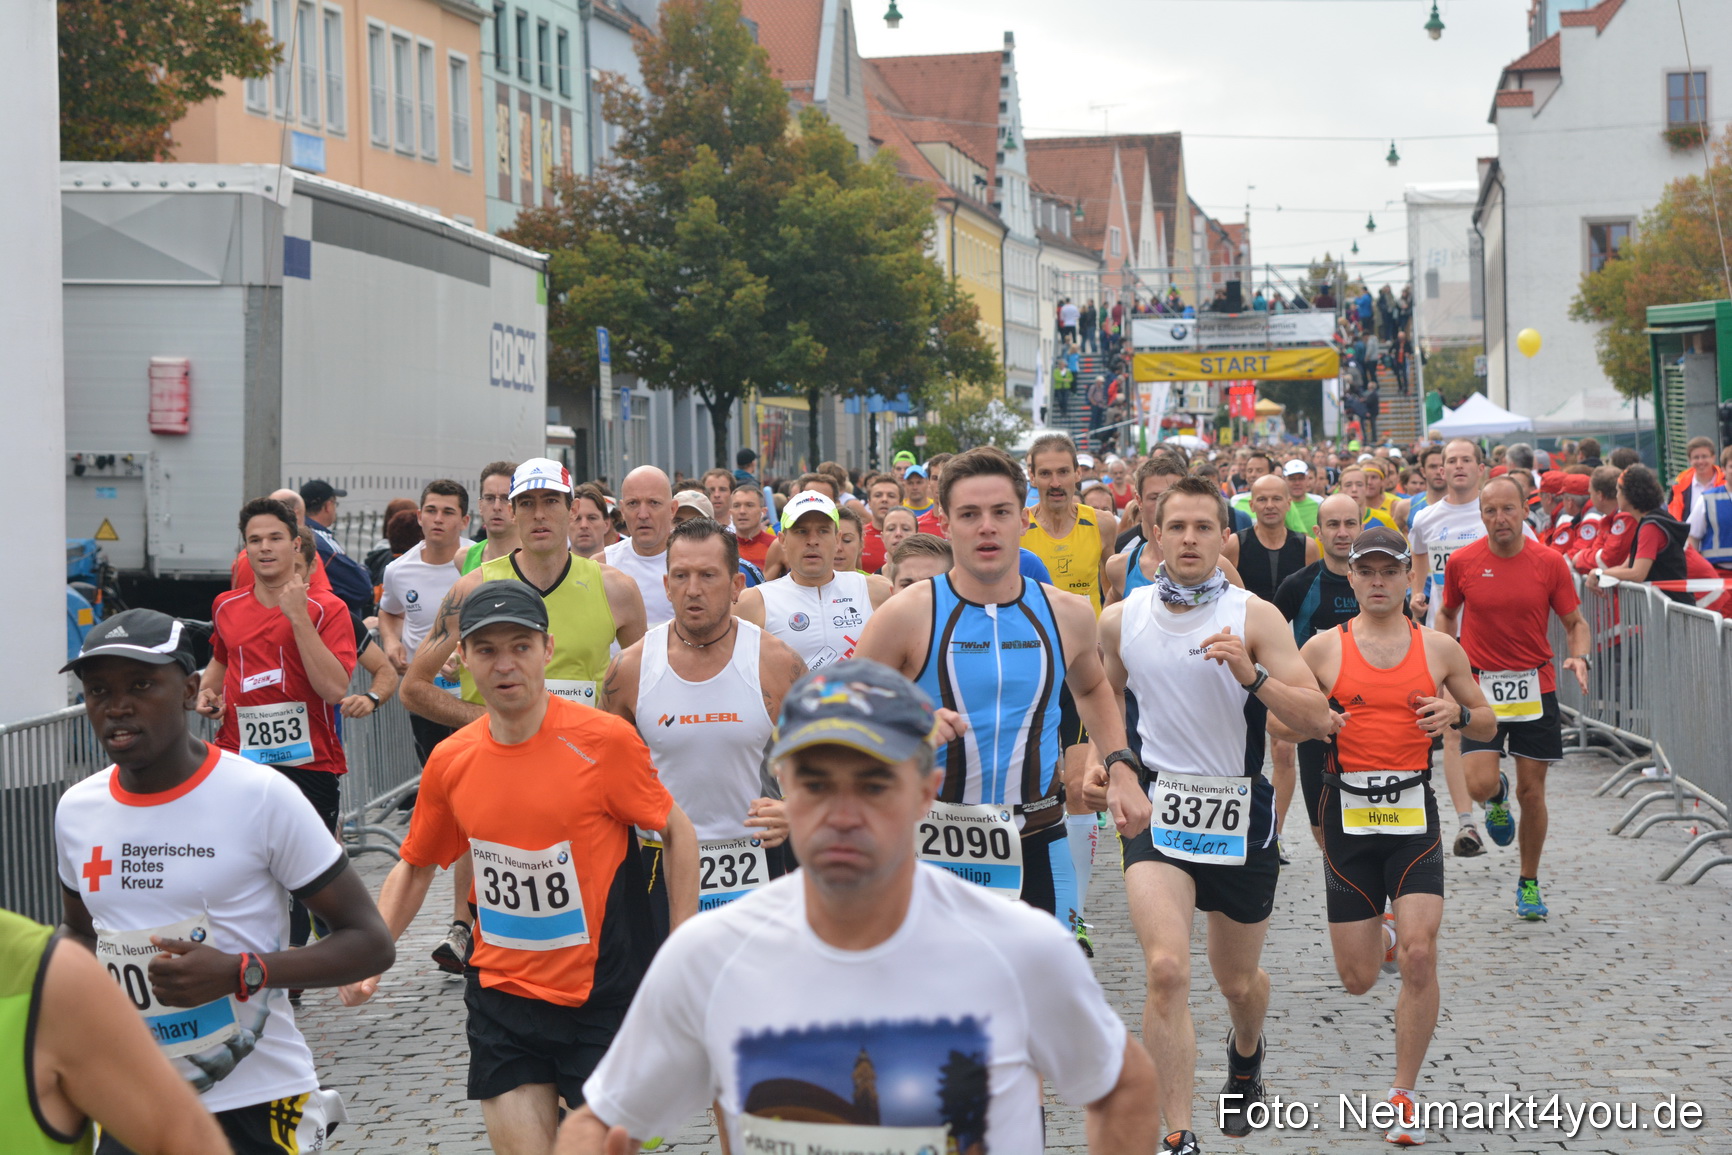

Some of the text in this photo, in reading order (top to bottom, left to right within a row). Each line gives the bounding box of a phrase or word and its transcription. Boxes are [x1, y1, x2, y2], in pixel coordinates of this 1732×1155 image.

[490, 322, 536, 392] BOCK
[1200, 355, 1271, 374] START
[546, 689, 582, 697] eumarkt
[1492, 679, 1529, 702] 626
[239, 708, 294, 719] PARTL Neumarkt
[679, 712, 744, 725] KLEBL
[245, 717, 302, 746] 2853
[260, 750, 292, 762] Florian
[1158, 779, 1235, 795] PARTL Neumarkt
[945, 813, 997, 823] Neumarkt
[1161, 792, 1241, 831] 3376
[1368, 811, 1400, 825] Hynek
[701, 839, 747, 852] Neumarkt
[919, 823, 1012, 860] 2090
[1162, 830, 1229, 856] Stefan
[121, 843, 216, 859] Bayerisches
[121, 859, 164, 873] Rotes
[473, 848, 554, 871] PARTL Neumarkt
[699, 851, 760, 890] 232
[121, 876, 164, 890] Kreuz
[483, 866, 570, 912] 3318
[98, 939, 122, 956] PARTL
